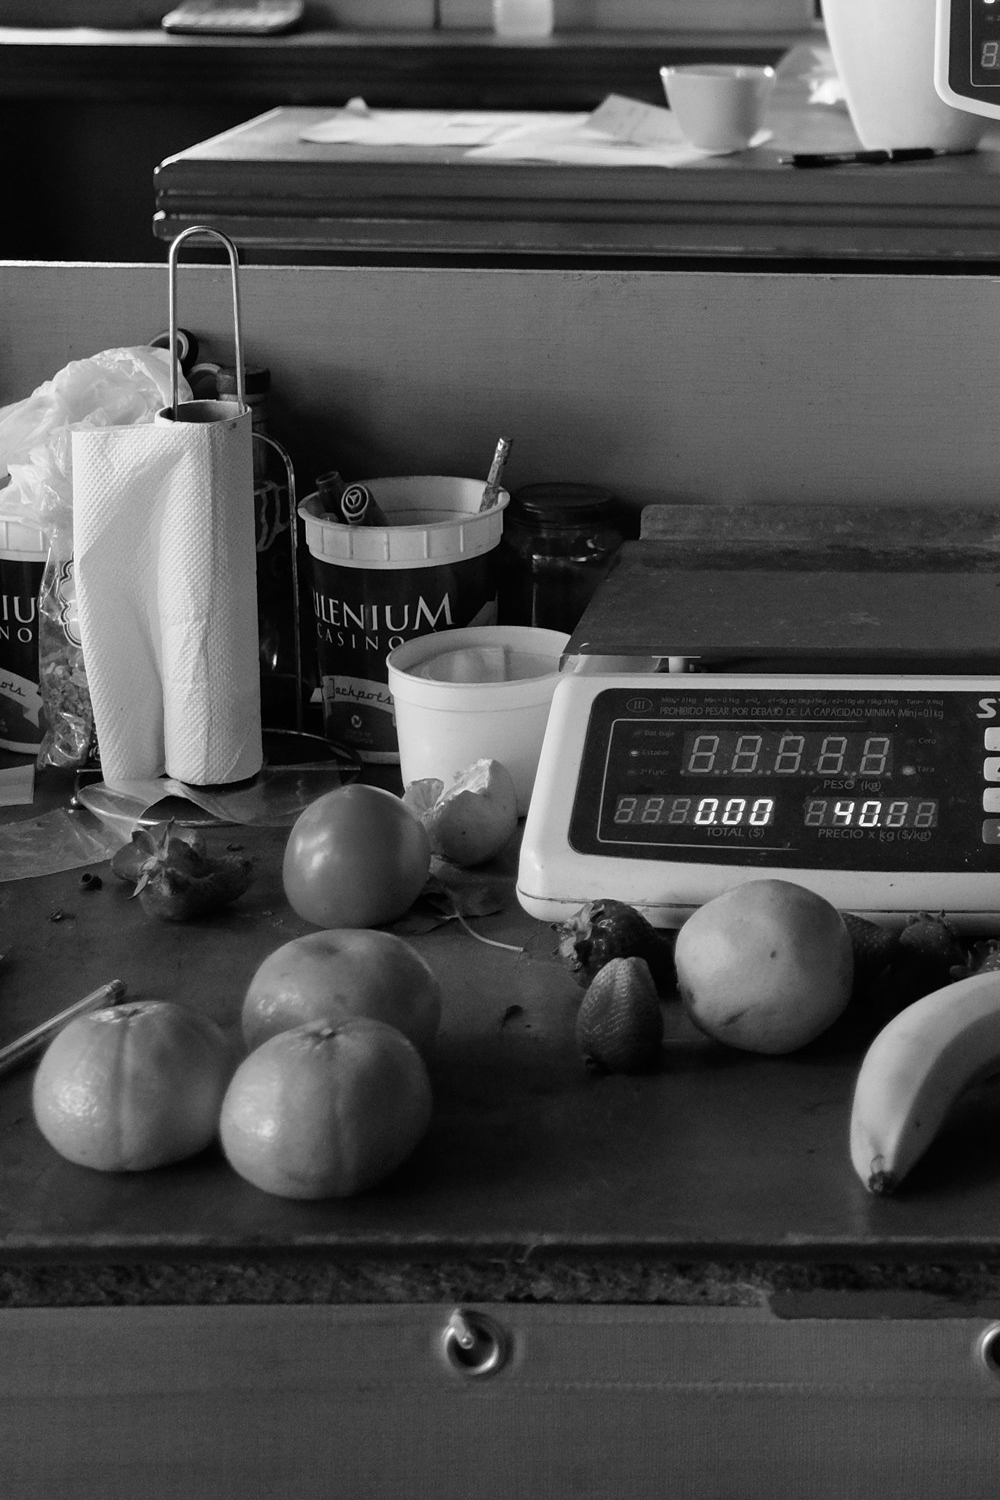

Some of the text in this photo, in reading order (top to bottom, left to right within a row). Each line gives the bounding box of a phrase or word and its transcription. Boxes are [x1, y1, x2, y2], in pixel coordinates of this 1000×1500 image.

[705, 706, 729, 716] PESAR
[732, 706, 749, 716] POR
[750, 707, 784, 717] DEBAJO
[786, 707, 798, 716] DE
[799, 707, 812, 717] LA
[813, 707, 863, 717] CAPACIDAD
[823, 779, 882, 792] PESO (kg)
[706, 827, 765, 839] TOTAL ($)
[817, 828, 864, 839] PRECIO
